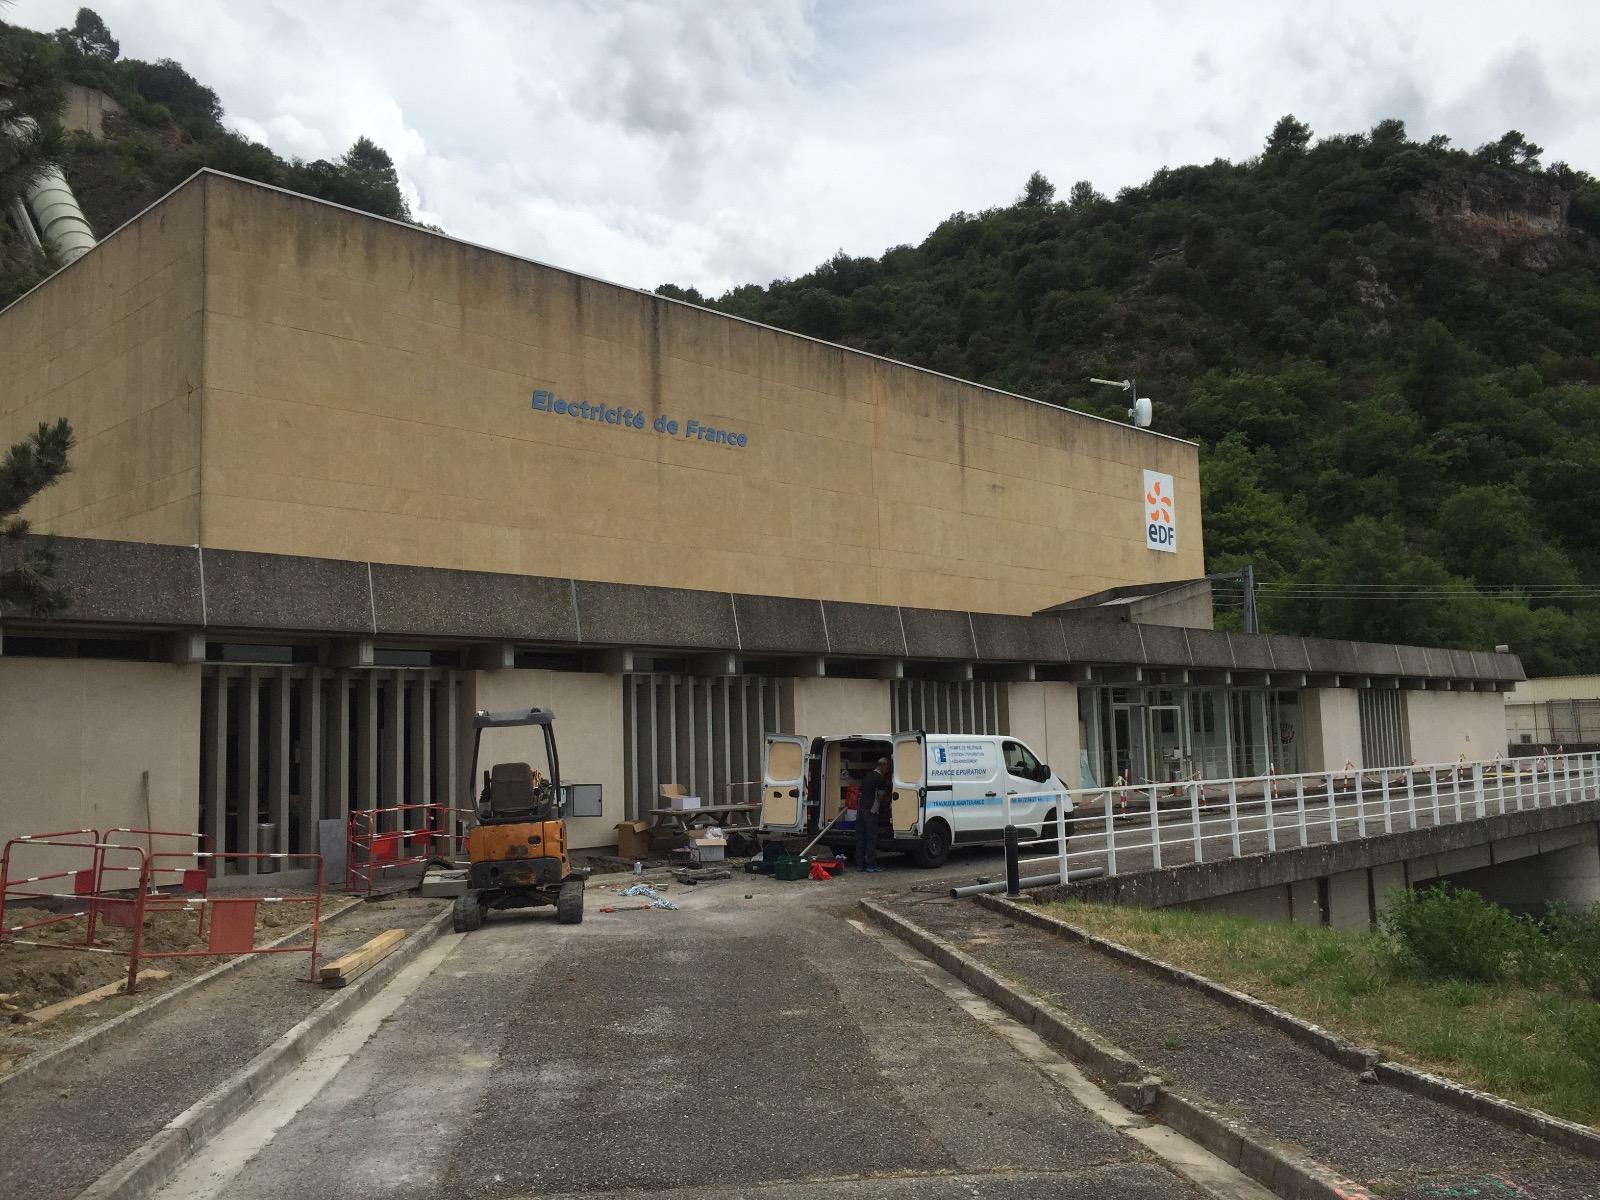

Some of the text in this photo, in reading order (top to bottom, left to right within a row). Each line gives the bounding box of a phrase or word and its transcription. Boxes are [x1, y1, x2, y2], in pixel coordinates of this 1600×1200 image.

[531, 389, 748, 447] Electricité de France
[931, 768, 987, 777] FRANCE EPURATION
